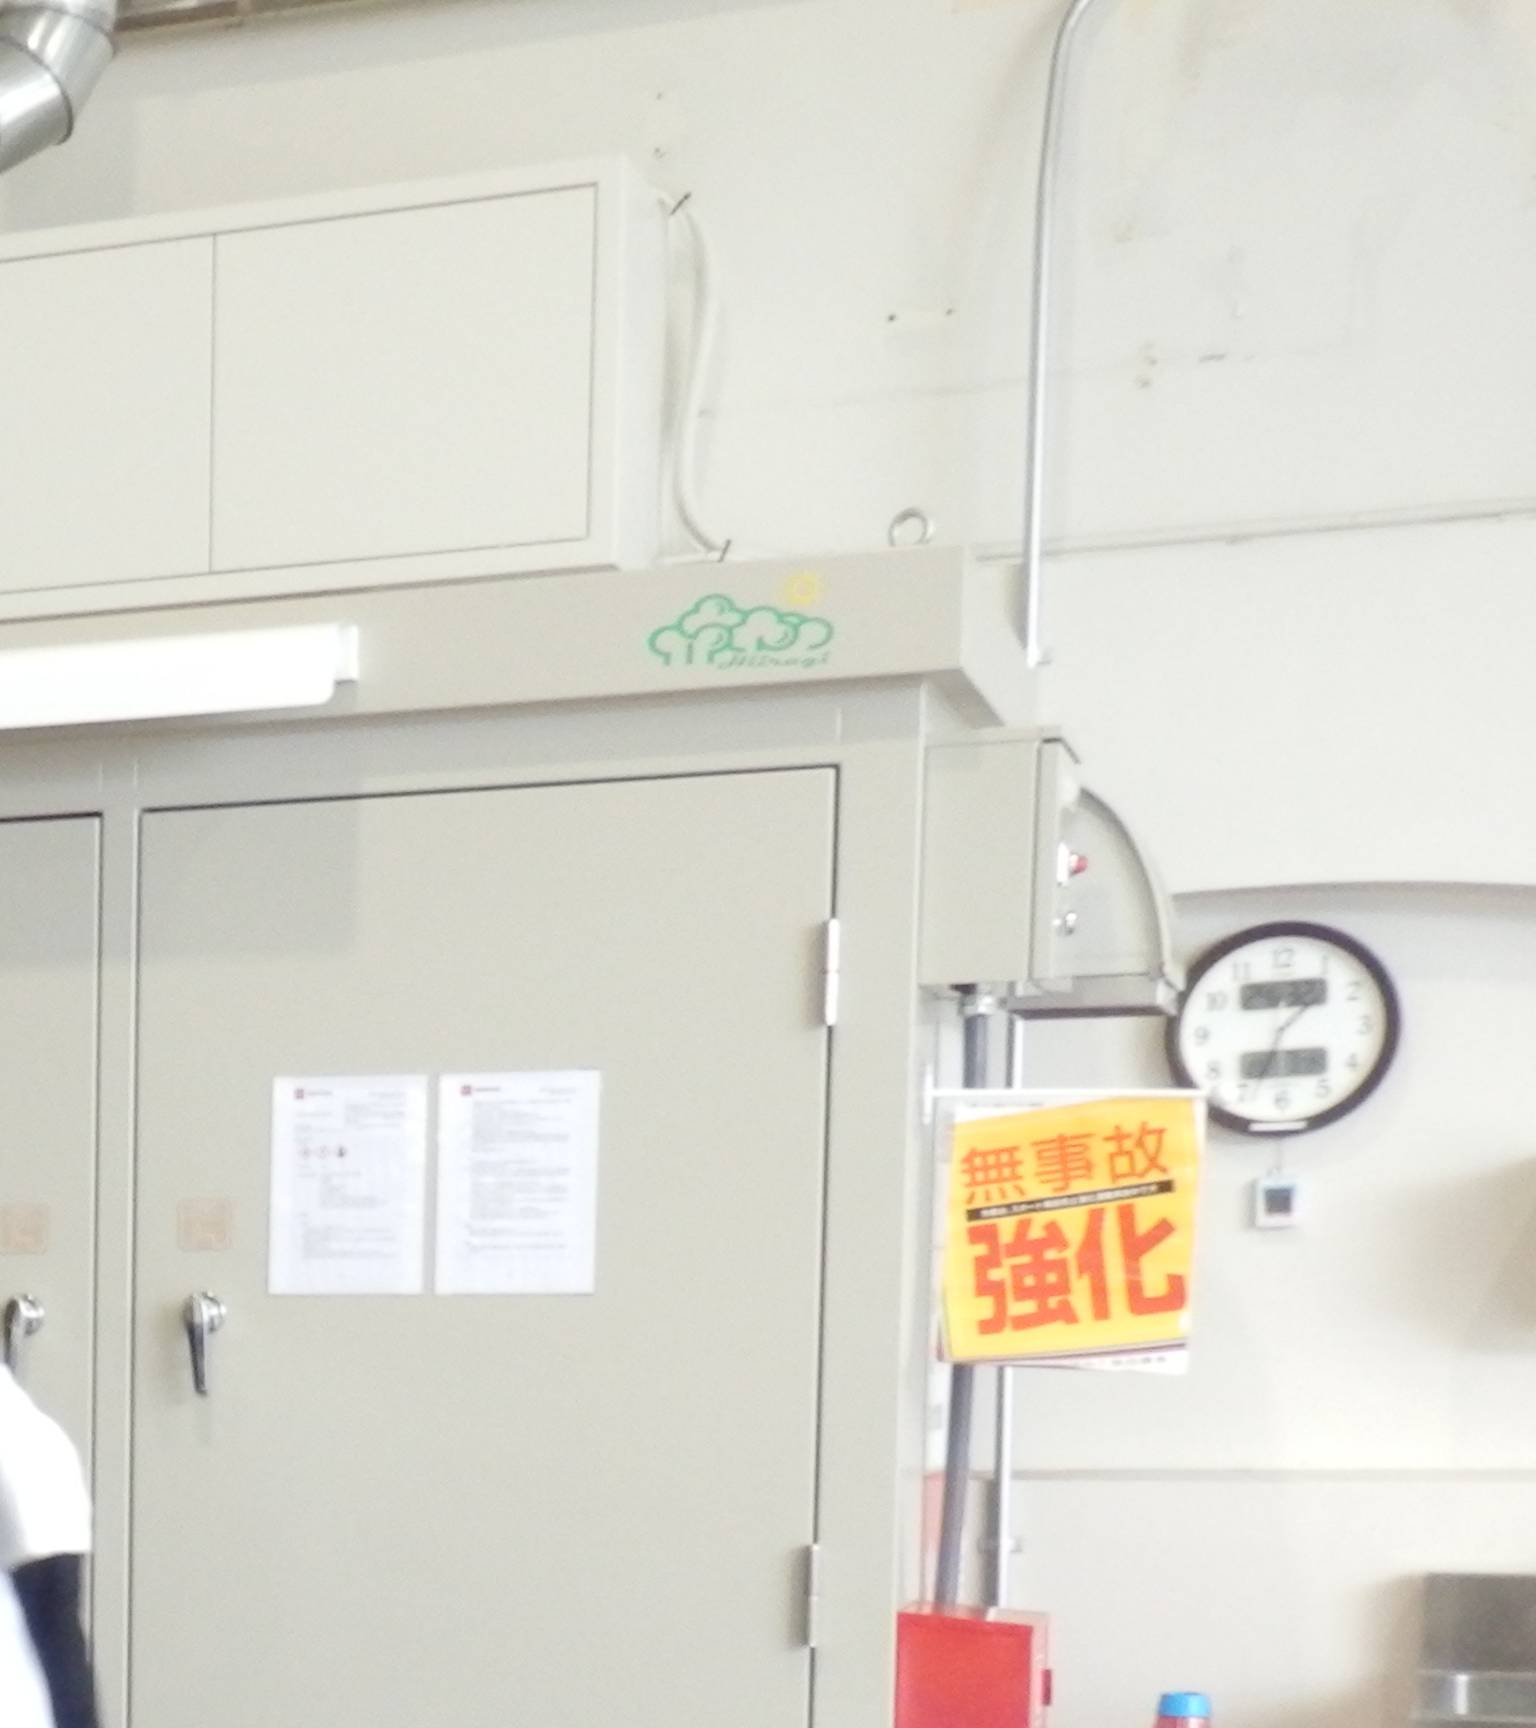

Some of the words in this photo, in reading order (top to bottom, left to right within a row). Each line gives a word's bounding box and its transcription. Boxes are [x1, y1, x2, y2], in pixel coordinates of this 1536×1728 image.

[960, 1121, 1168, 1205] 無事故
[966, 1203, 1187, 1335] 強化
